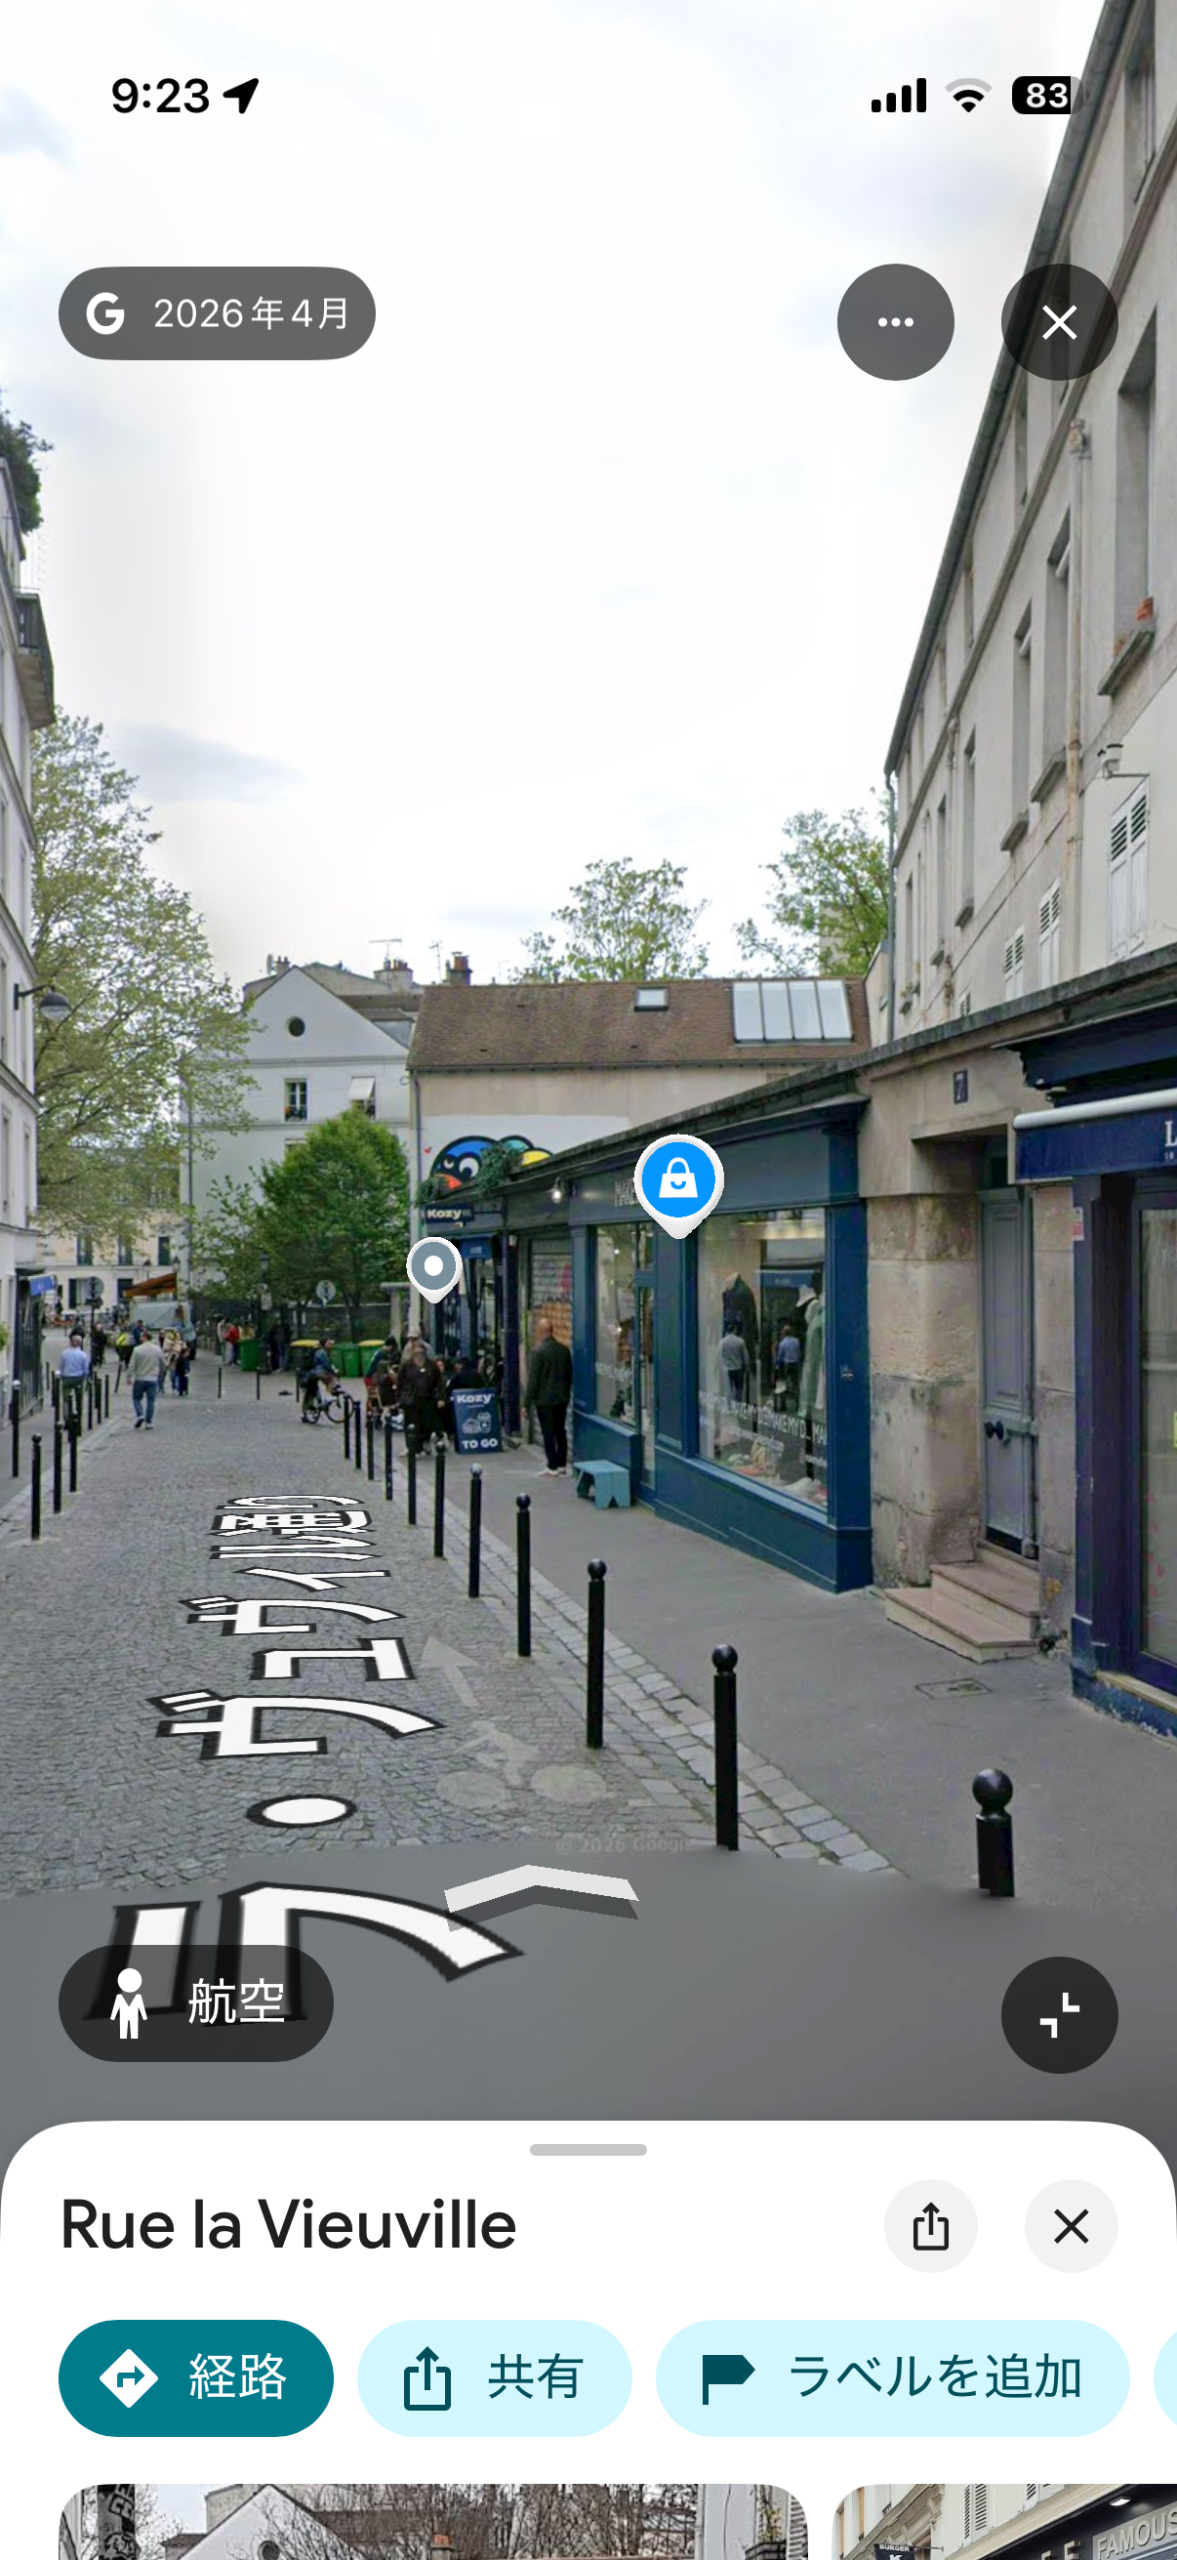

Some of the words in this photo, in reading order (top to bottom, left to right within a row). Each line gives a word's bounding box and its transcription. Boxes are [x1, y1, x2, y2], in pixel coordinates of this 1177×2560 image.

[954, 1073, 964, 1101] 7
[427, 1208, 462, 1219] Kozy
[456, 1394, 492, 1404] Kozy
[462, 1440, 479, 1449] TO
[480, 1438, 498, 1448] GO
[1097, 2508, 1177, 2560] FAMOUS
[879, 2543, 910, 2552] BURGER
